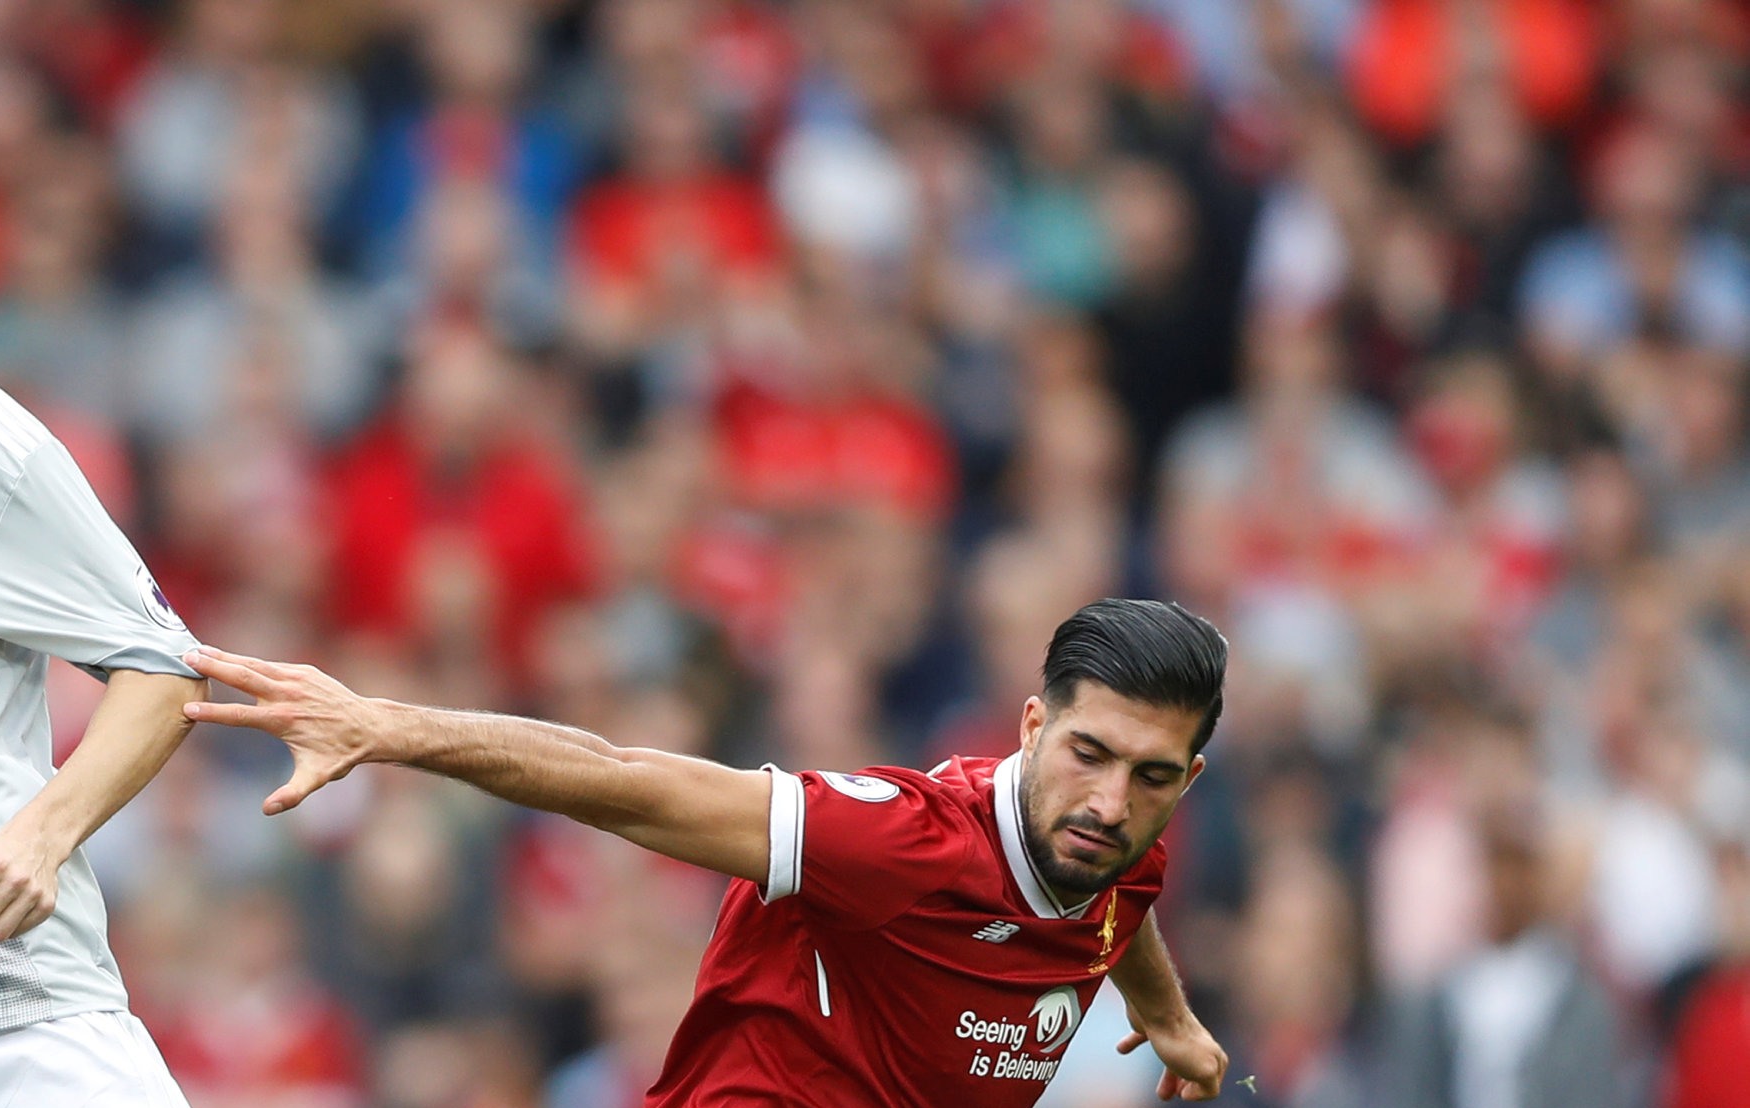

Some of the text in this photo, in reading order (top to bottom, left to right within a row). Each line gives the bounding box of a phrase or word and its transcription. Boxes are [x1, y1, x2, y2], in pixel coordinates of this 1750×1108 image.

[955, 1010, 1028, 1052] Seeing
[969, 1048, 1059, 1085] is Believing
